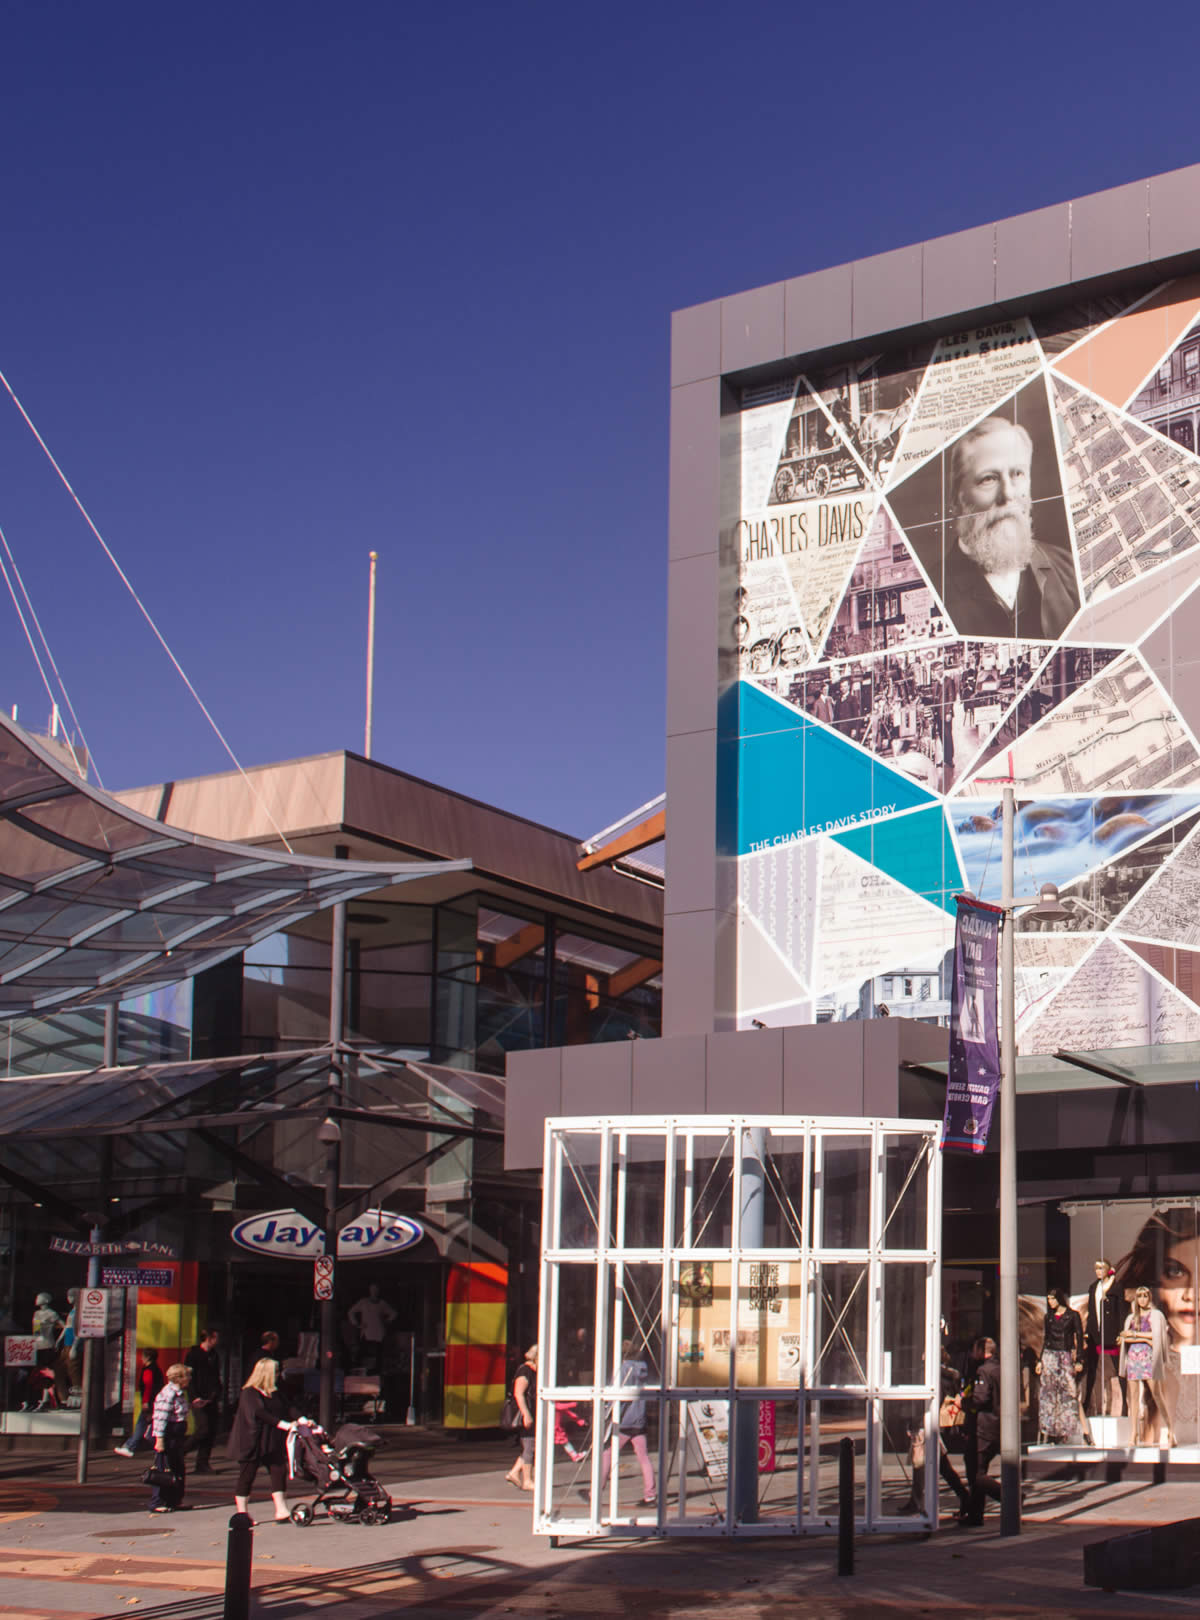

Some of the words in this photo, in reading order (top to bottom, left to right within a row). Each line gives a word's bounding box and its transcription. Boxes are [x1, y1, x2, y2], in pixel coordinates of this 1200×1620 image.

[735, 511, 809, 562] CHARLES
[818, 500, 865, 548] DAVIS
[749, 838, 771, 853] THE
[773, 823, 823, 847] CHARLES
[825, 813, 858, 833] DAVIS
[859, 803, 897, 822] STORY
[252, 1220, 320, 1247] Jay
[319, 1226, 404, 1247] ays
[53, 1238, 122, 1255] ELIZABETH
[749, 1286, 780, 1300] CHEAP
[749, 1299, 775, 1311] SKATE
